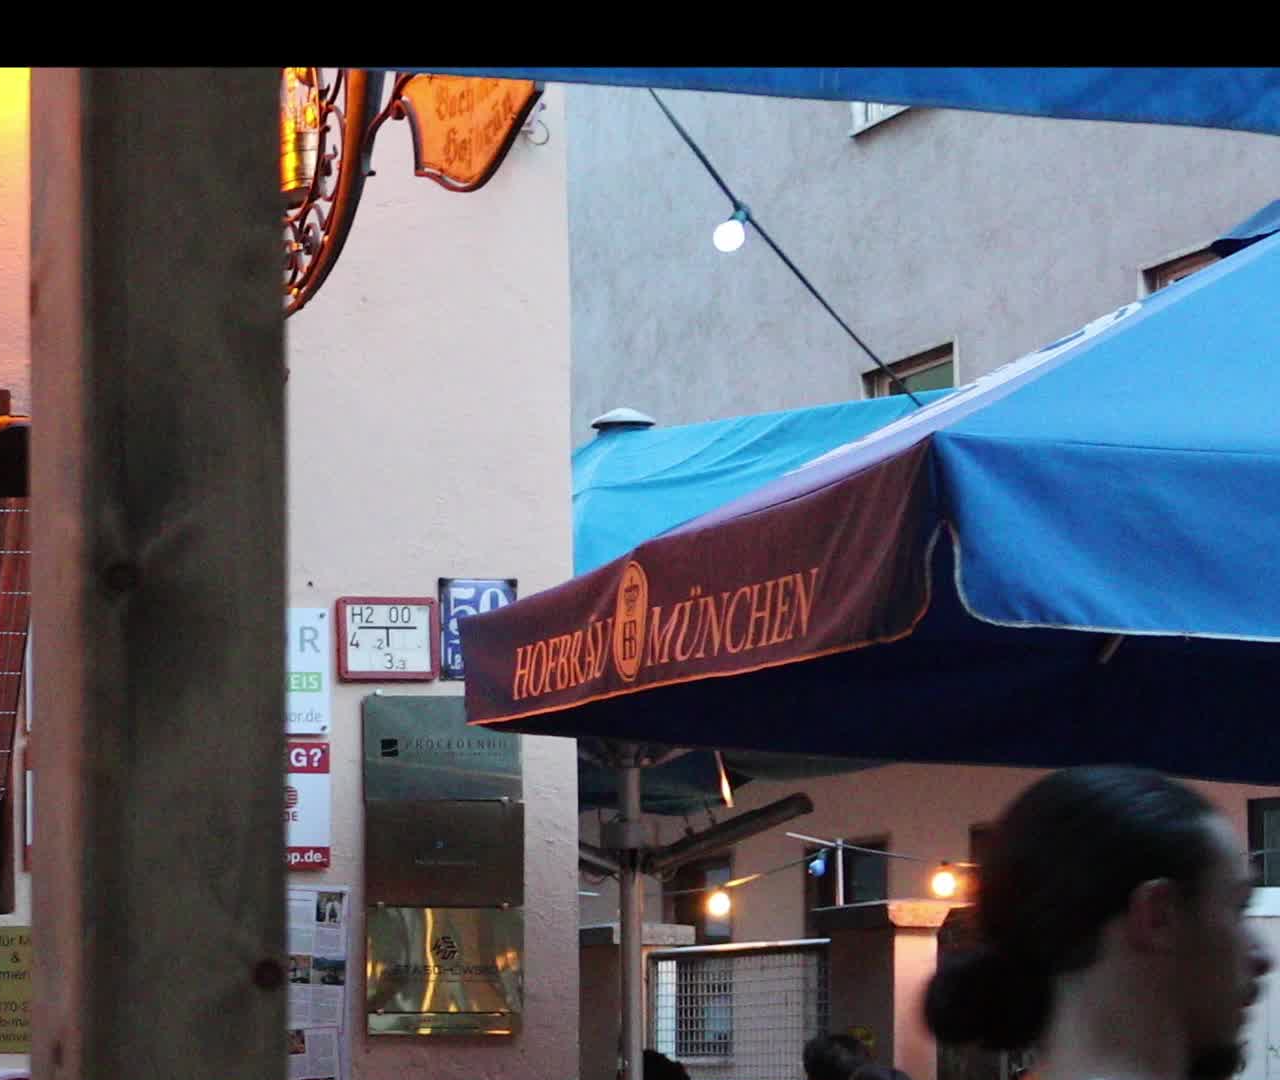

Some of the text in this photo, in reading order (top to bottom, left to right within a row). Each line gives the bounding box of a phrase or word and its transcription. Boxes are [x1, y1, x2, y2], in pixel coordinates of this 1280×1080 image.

[298, 626, 320, 653] R
[512, 612, 614, 701] HOFBRÄU
[646, 567, 820, 667] MÜNCHEN
[289, 674, 320, 689] EIS
[289, 747, 323, 768] G?
